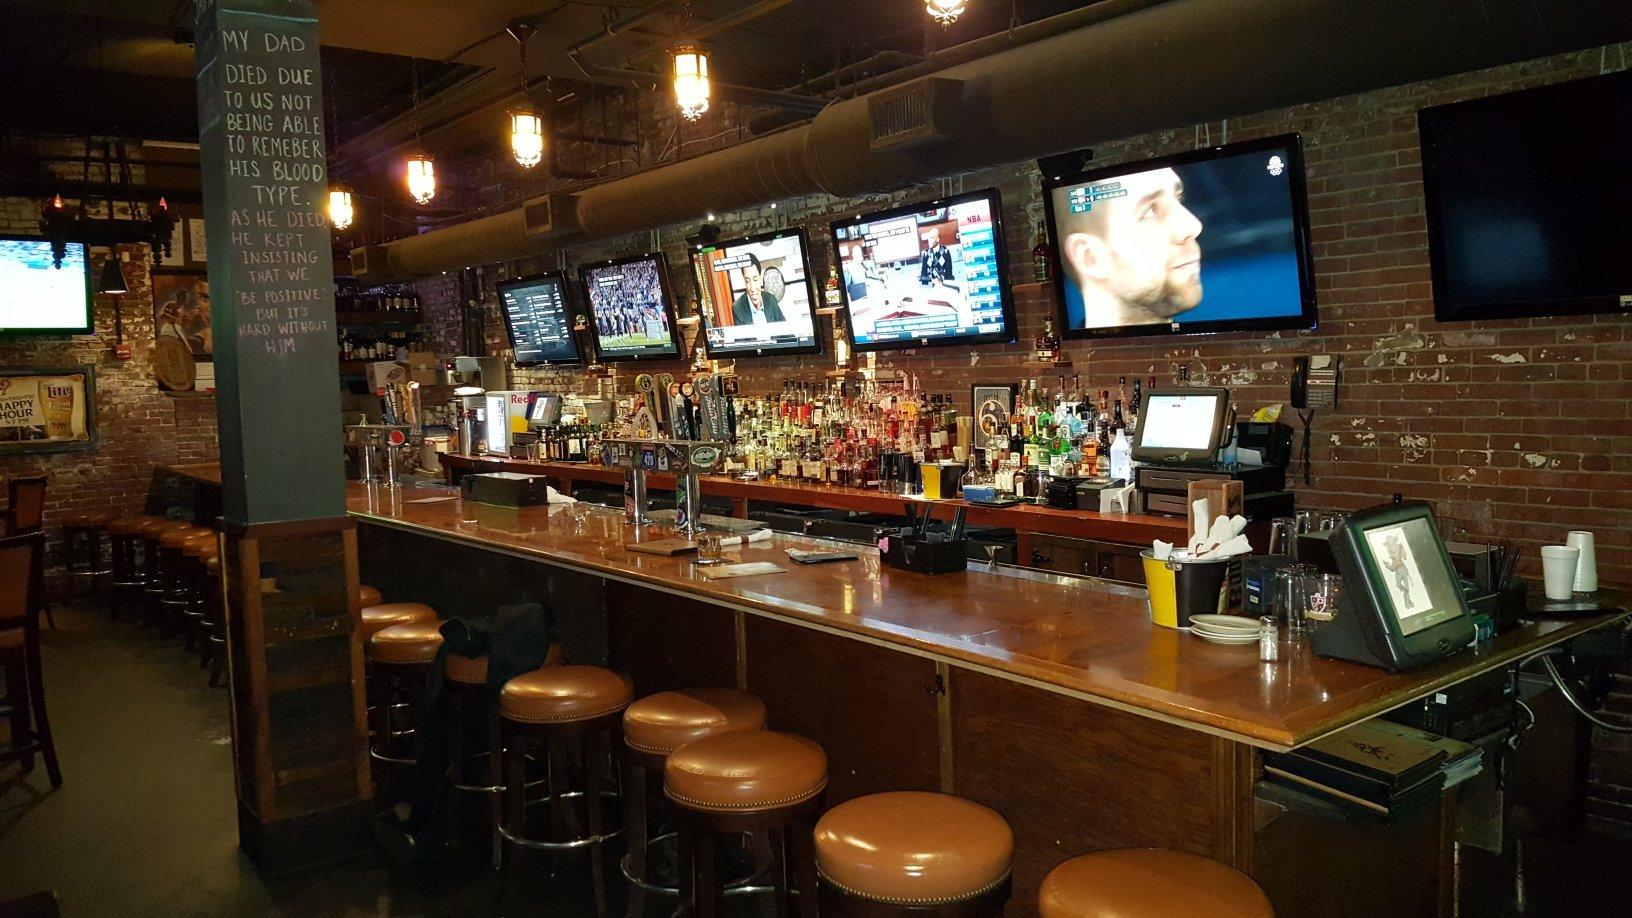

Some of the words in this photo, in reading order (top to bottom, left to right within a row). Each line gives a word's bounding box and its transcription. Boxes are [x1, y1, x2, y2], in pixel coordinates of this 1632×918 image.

[222, 30, 249, 51] MY
[264, 32, 305, 52] DAD
[225, 64, 267, 85] DIED
[278, 67, 314, 86] DUE
[224, 90, 243, 109] TO
[251, 92, 274, 110] US
[282, 94, 313, 111] NOT
[226, 113, 274, 132] BEING
[282, 115, 322, 135] ABLE
[226, 134, 245, 154] TO
[252, 135, 325, 159] REMEBER
[229, 159, 261, 178] HIS
[272, 160, 324, 183] BLOOD
[231, 208, 251, 227] AS
[256, 210, 278, 227] HE
[967, 214, 981, 224] NBA
[231, 232, 253, 246] HE
[264, 232, 305, 248] KEPT
[242, 250, 319, 264] INSISTING
[249, 268, 280, 284] THAT
[286, 267, 310, 281] WE
[256, 307, 280, 320] BUT
[287, 306, 310, 319] IT'S
[237, 322, 272, 337] HARD
[277, 320, 328, 335] WITHOUT
[265, 337, 297, 355] HIM
[47, 386, 71, 398] Lite
[0, 408, 34, 419] HOUR
